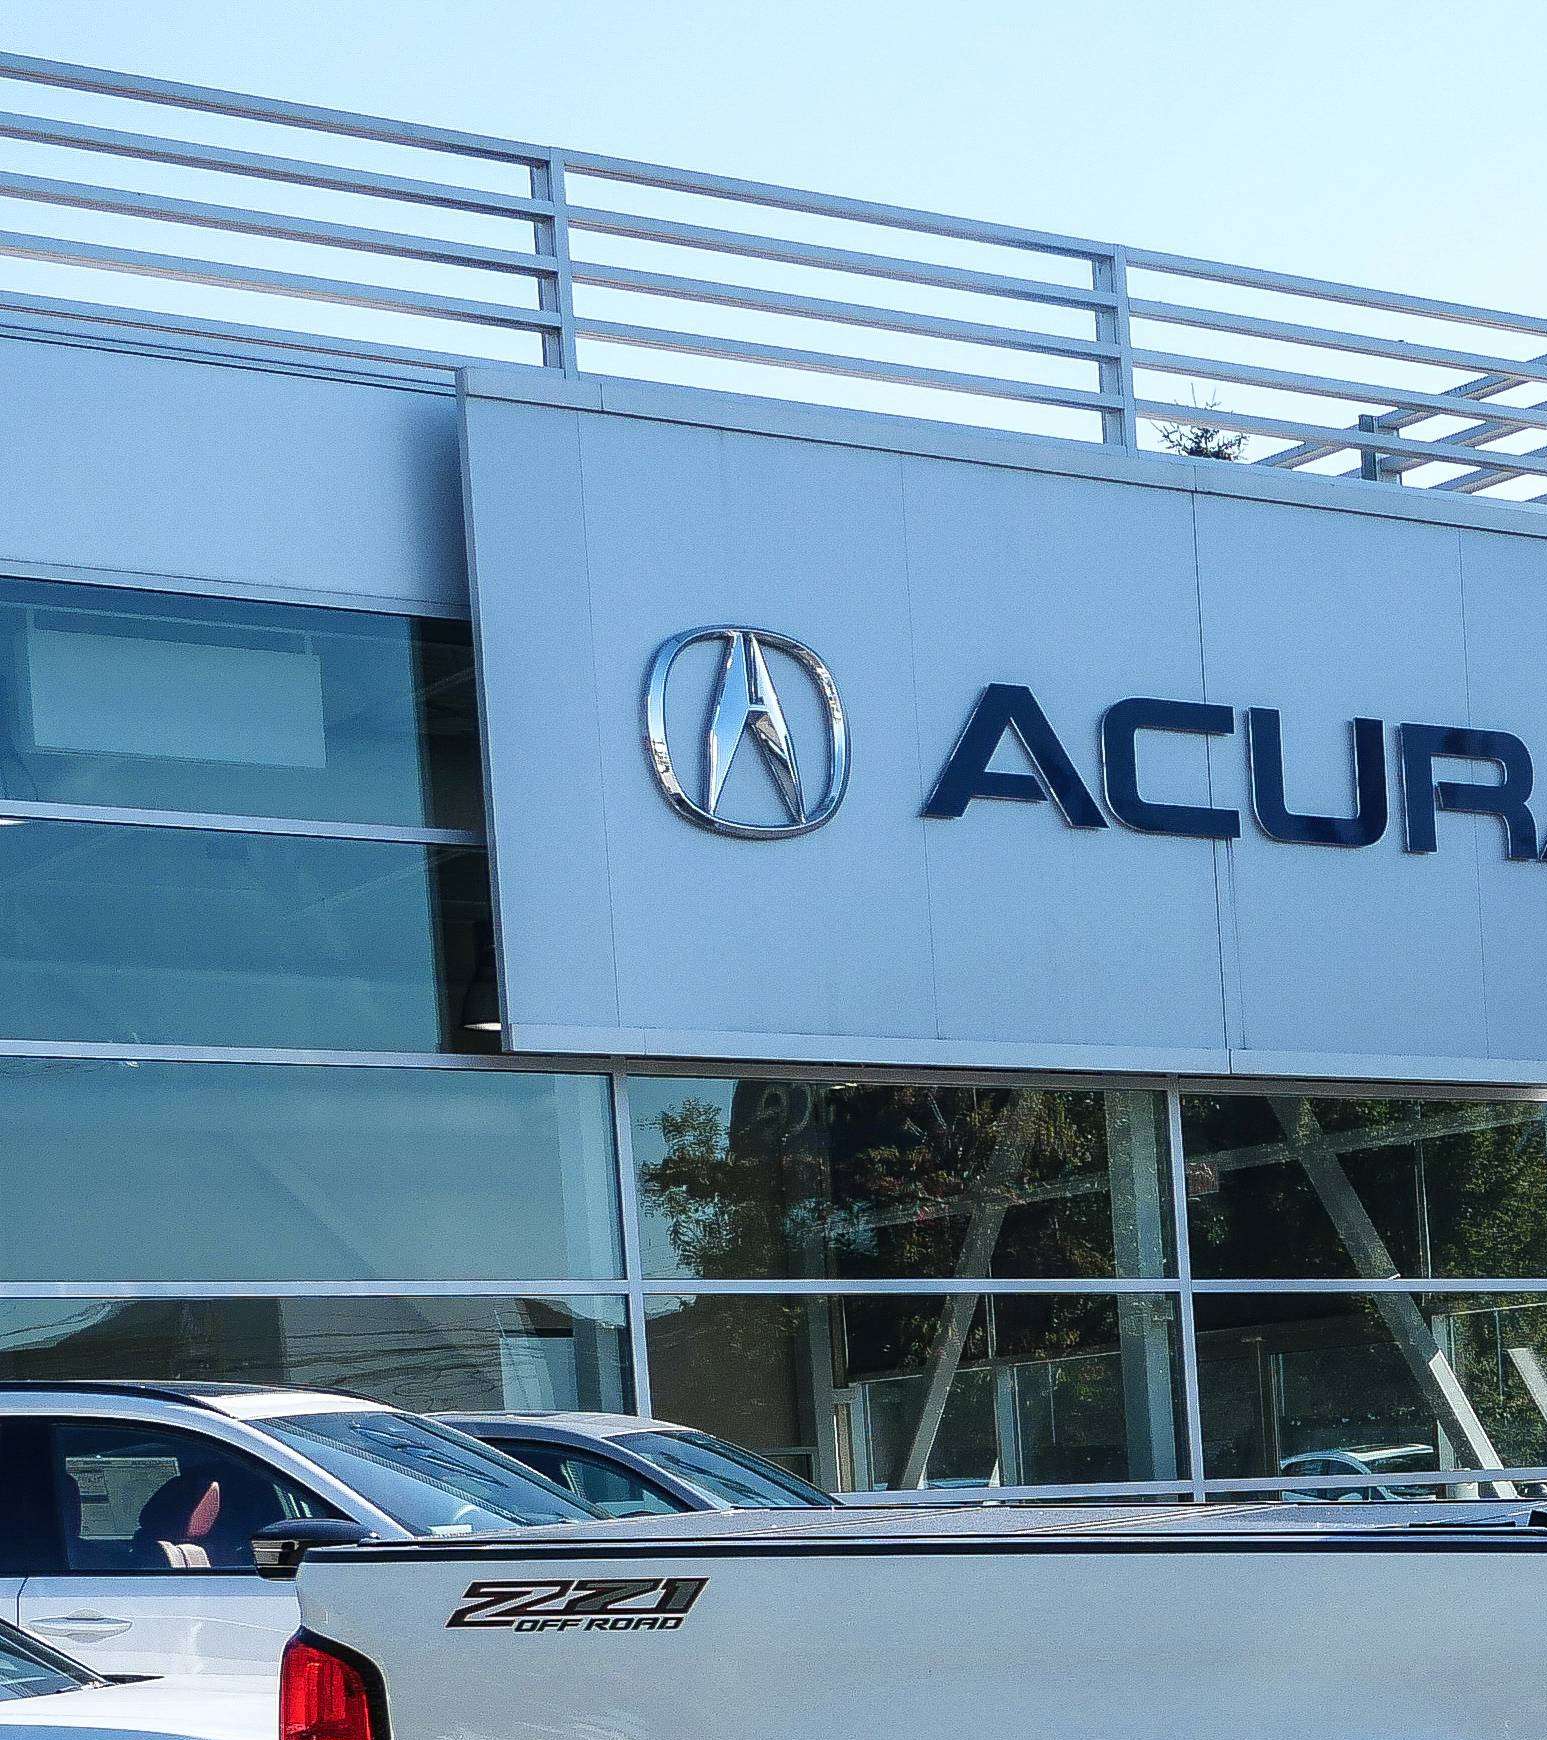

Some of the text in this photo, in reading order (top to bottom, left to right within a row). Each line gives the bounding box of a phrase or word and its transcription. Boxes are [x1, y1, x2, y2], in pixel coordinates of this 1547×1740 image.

[445, 1577, 711, 1629] Z71
[514, 1616, 684, 1632] OFF ROAD
